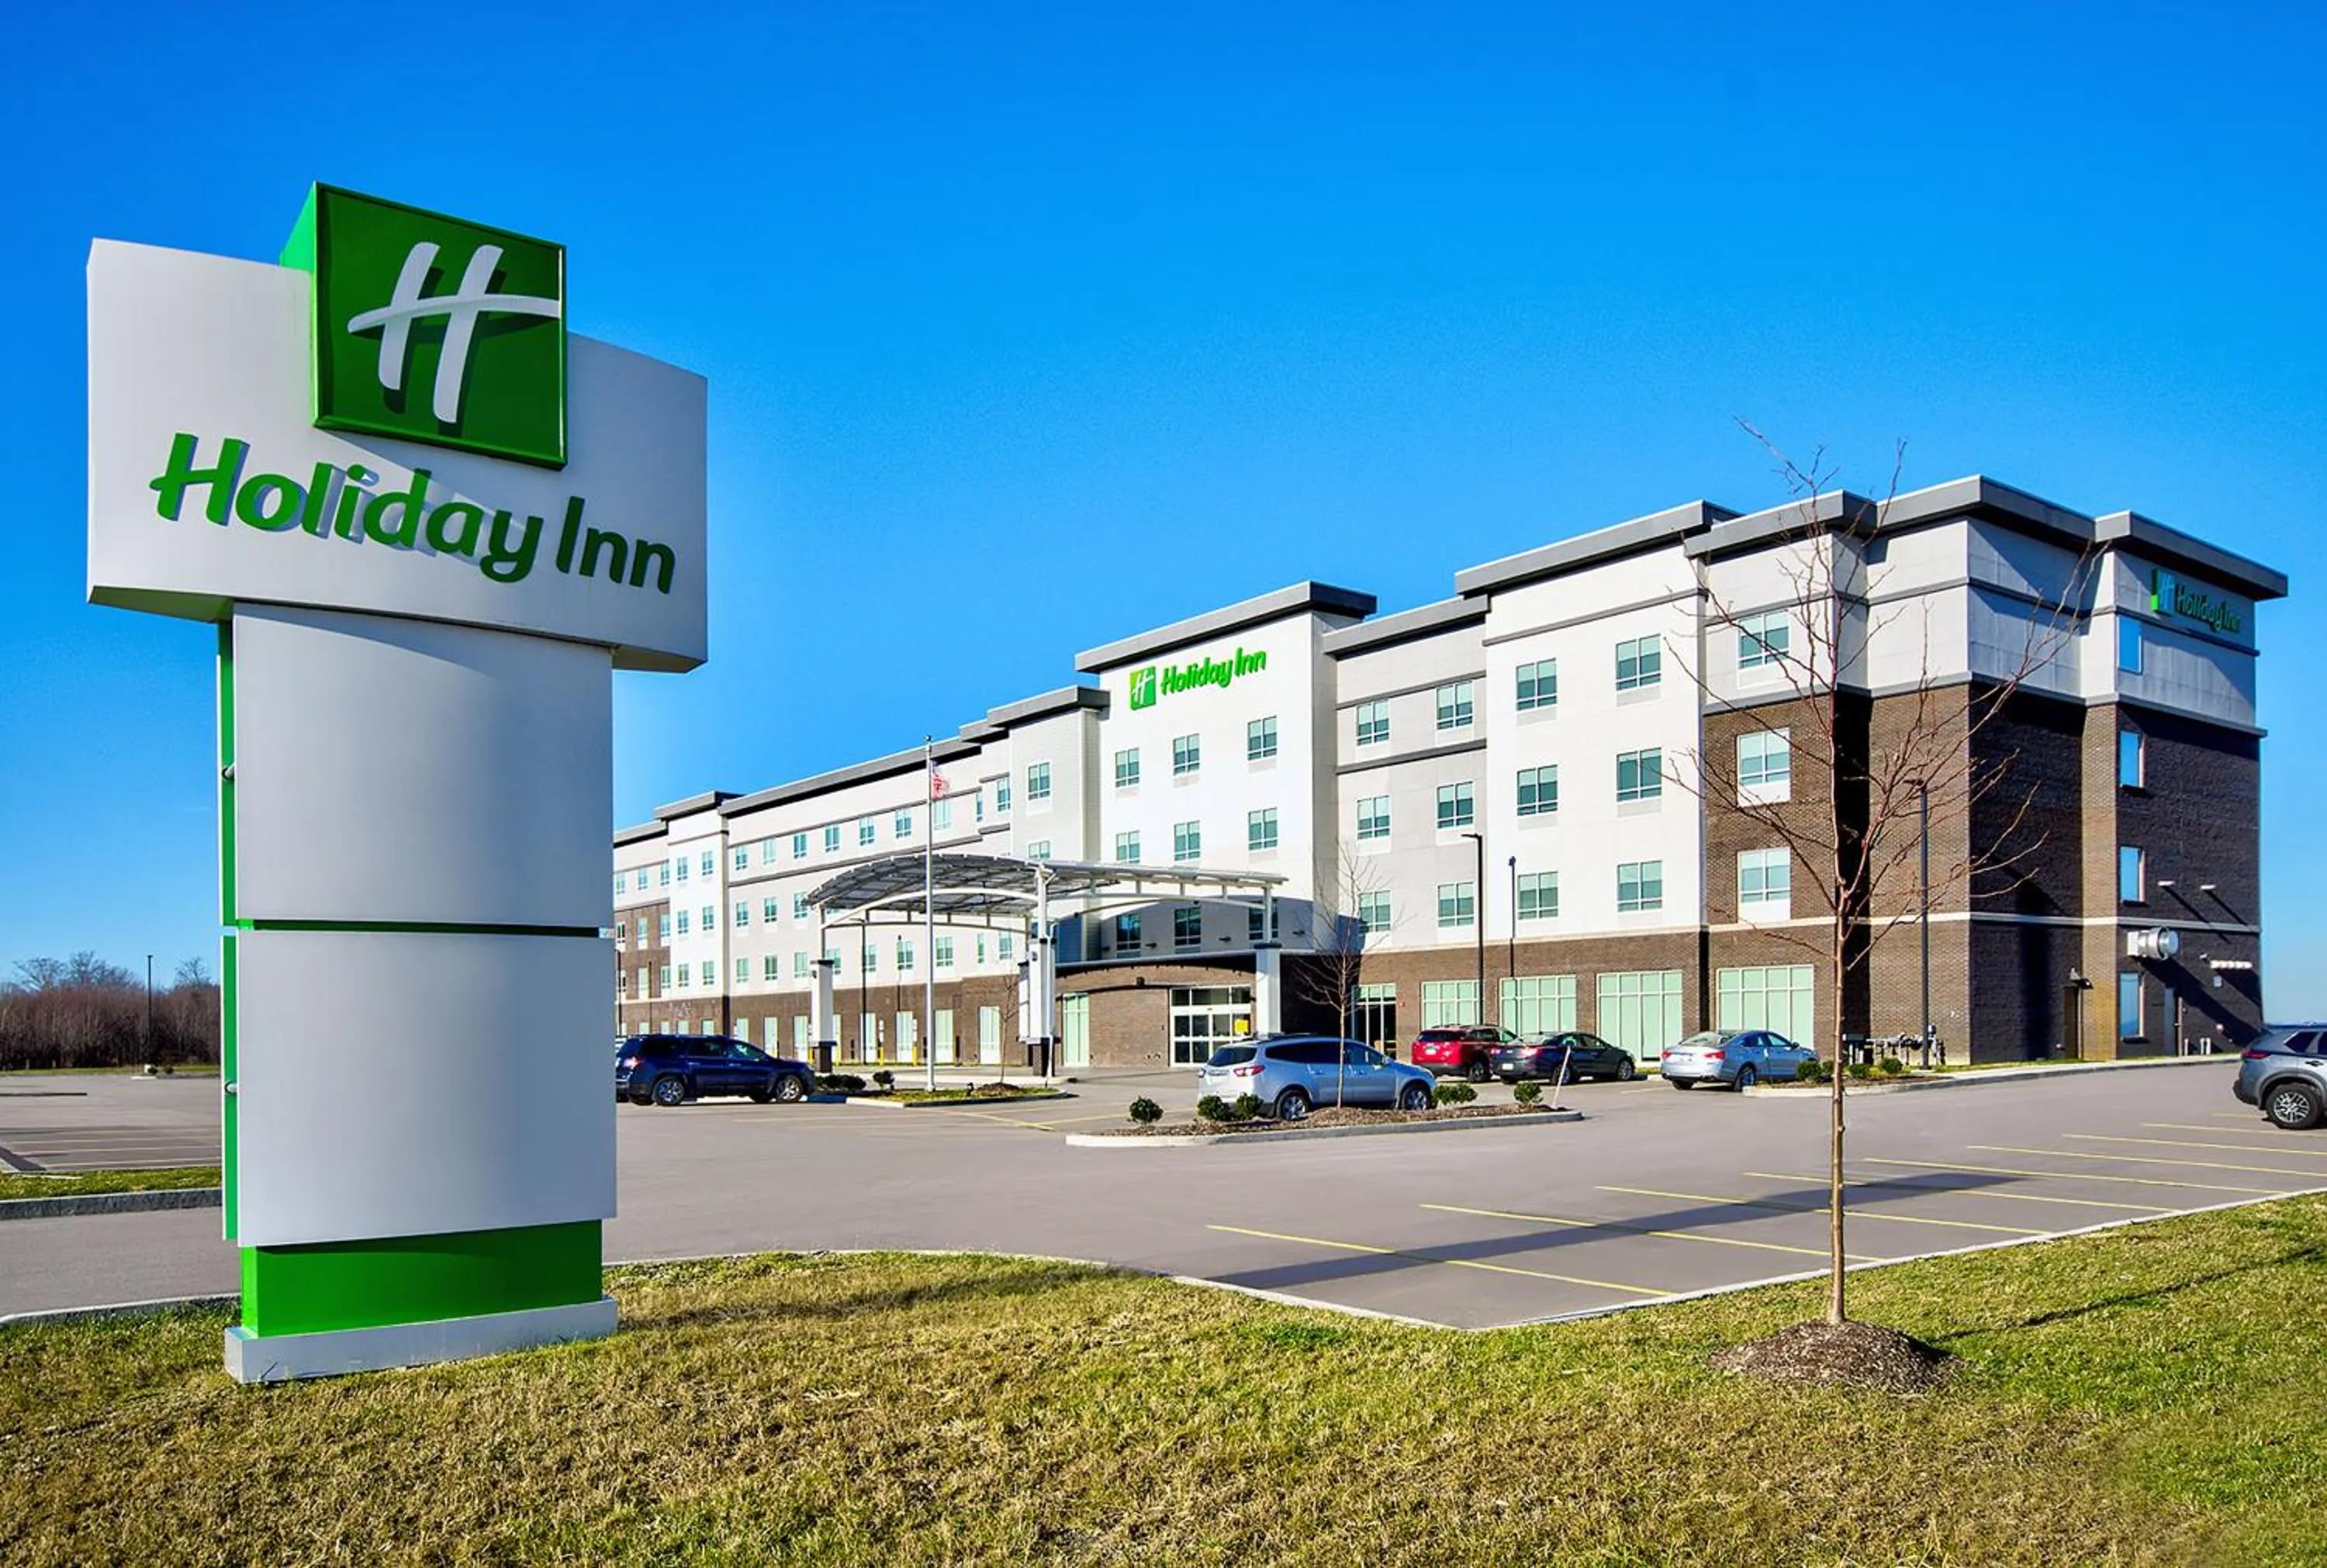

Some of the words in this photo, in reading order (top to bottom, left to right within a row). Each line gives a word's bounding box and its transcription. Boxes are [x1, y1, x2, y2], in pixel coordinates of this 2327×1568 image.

[149, 433, 545, 584] Holiday
[556, 496, 676, 594] Inn
[1160, 658, 1233, 696] Holiday
[1235, 647, 1267, 677] Inn
